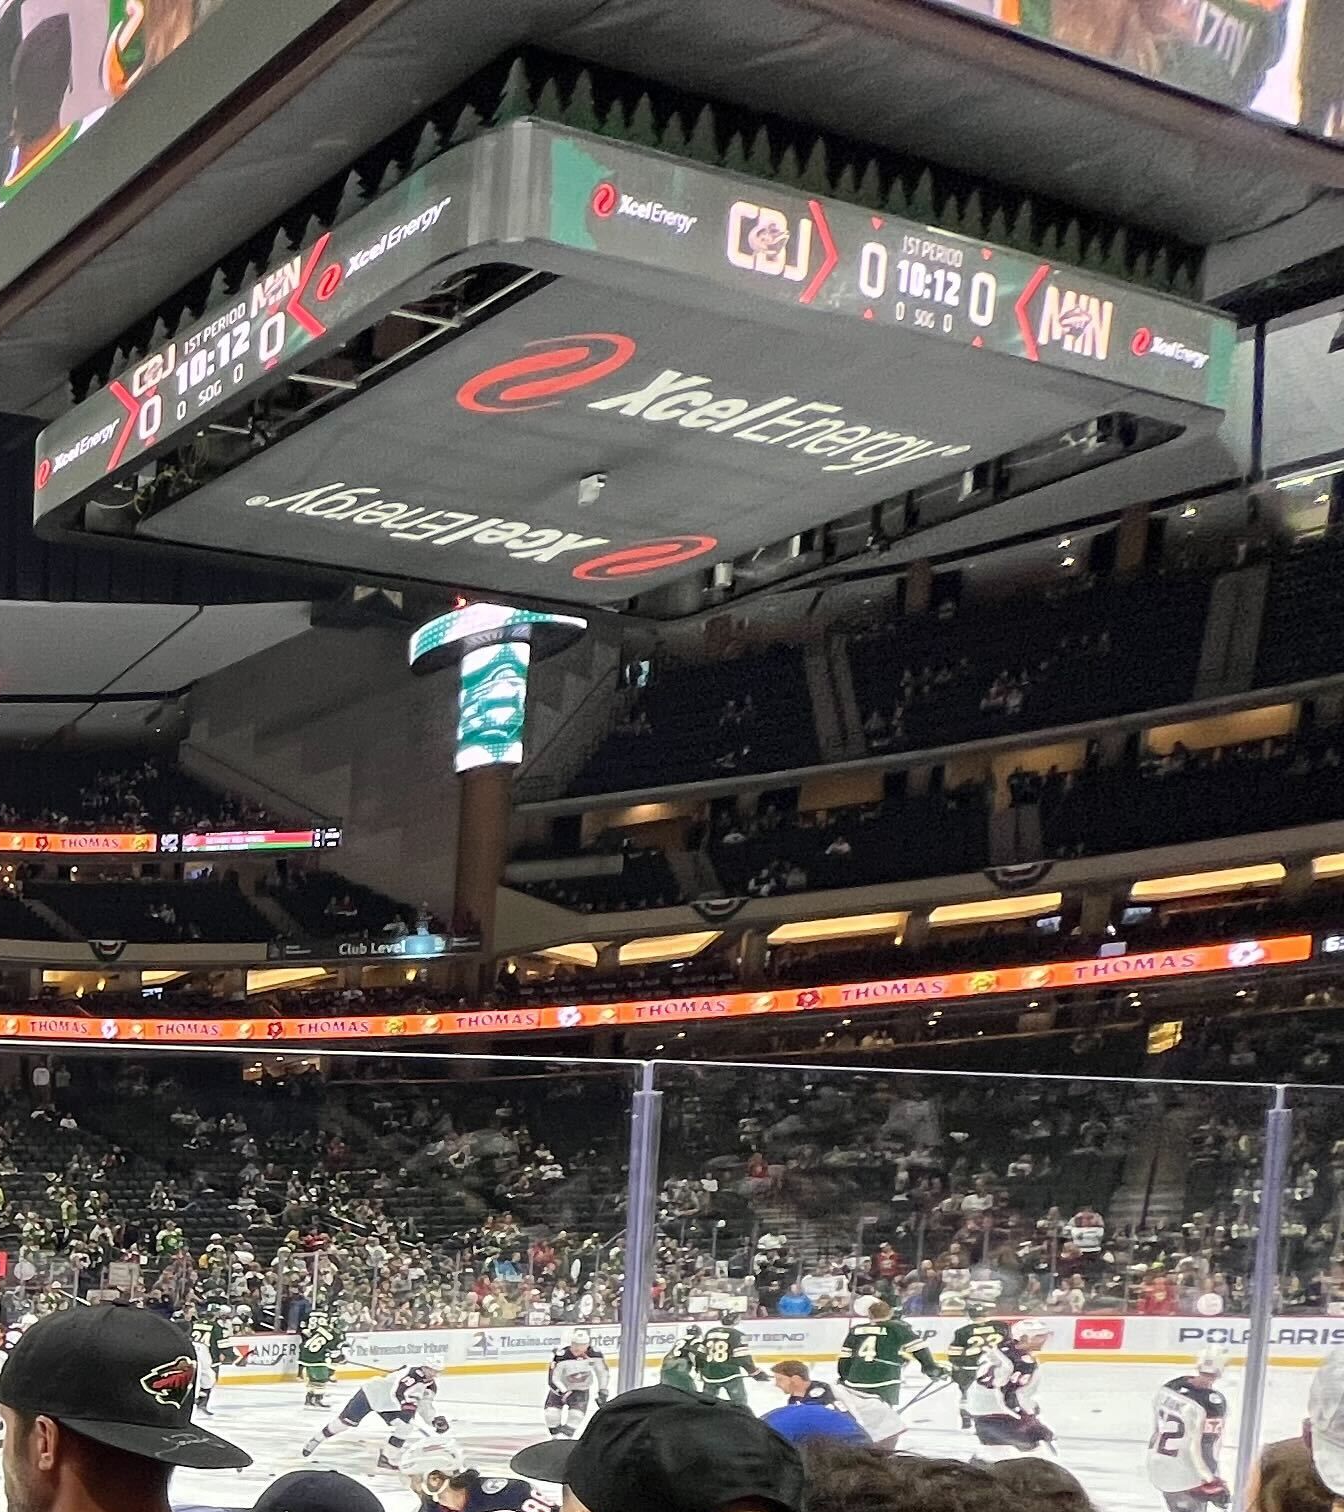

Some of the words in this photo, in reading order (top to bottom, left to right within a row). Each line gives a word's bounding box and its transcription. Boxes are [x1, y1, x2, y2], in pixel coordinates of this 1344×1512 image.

[919, 240, 964, 268] PERIOD
[859, 241, 888, 299] 0
[896, 260, 961, 307] 10:12
[968, 272, 997, 327] 0
[203, 302, 246, 343] PERIOD
[259, 311, 286, 362] 0
[176, 320, 251, 395] 10:12
[198, 379, 222, 407] SOG
[139, 394, 162, 440] 0
[59, 838, 119, 850] THOMAS
[339, 943, 367, 955] Club
[371, 940, 406, 954] Level
[1074, 953, 1196, 980] THOMAS
[842, 980, 945, 1002] THOMAS
[456, 1013, 536, 1030] THOMAS
[634, 999, 727, 1019] THOMAS
[29, 1021, 88, 1036] THOMAS
[156, 1022, 219, 1037] THOMAS
[297, 1020, 370, 1036] THOMAS
[859, 1335, 877, 1362] 4
